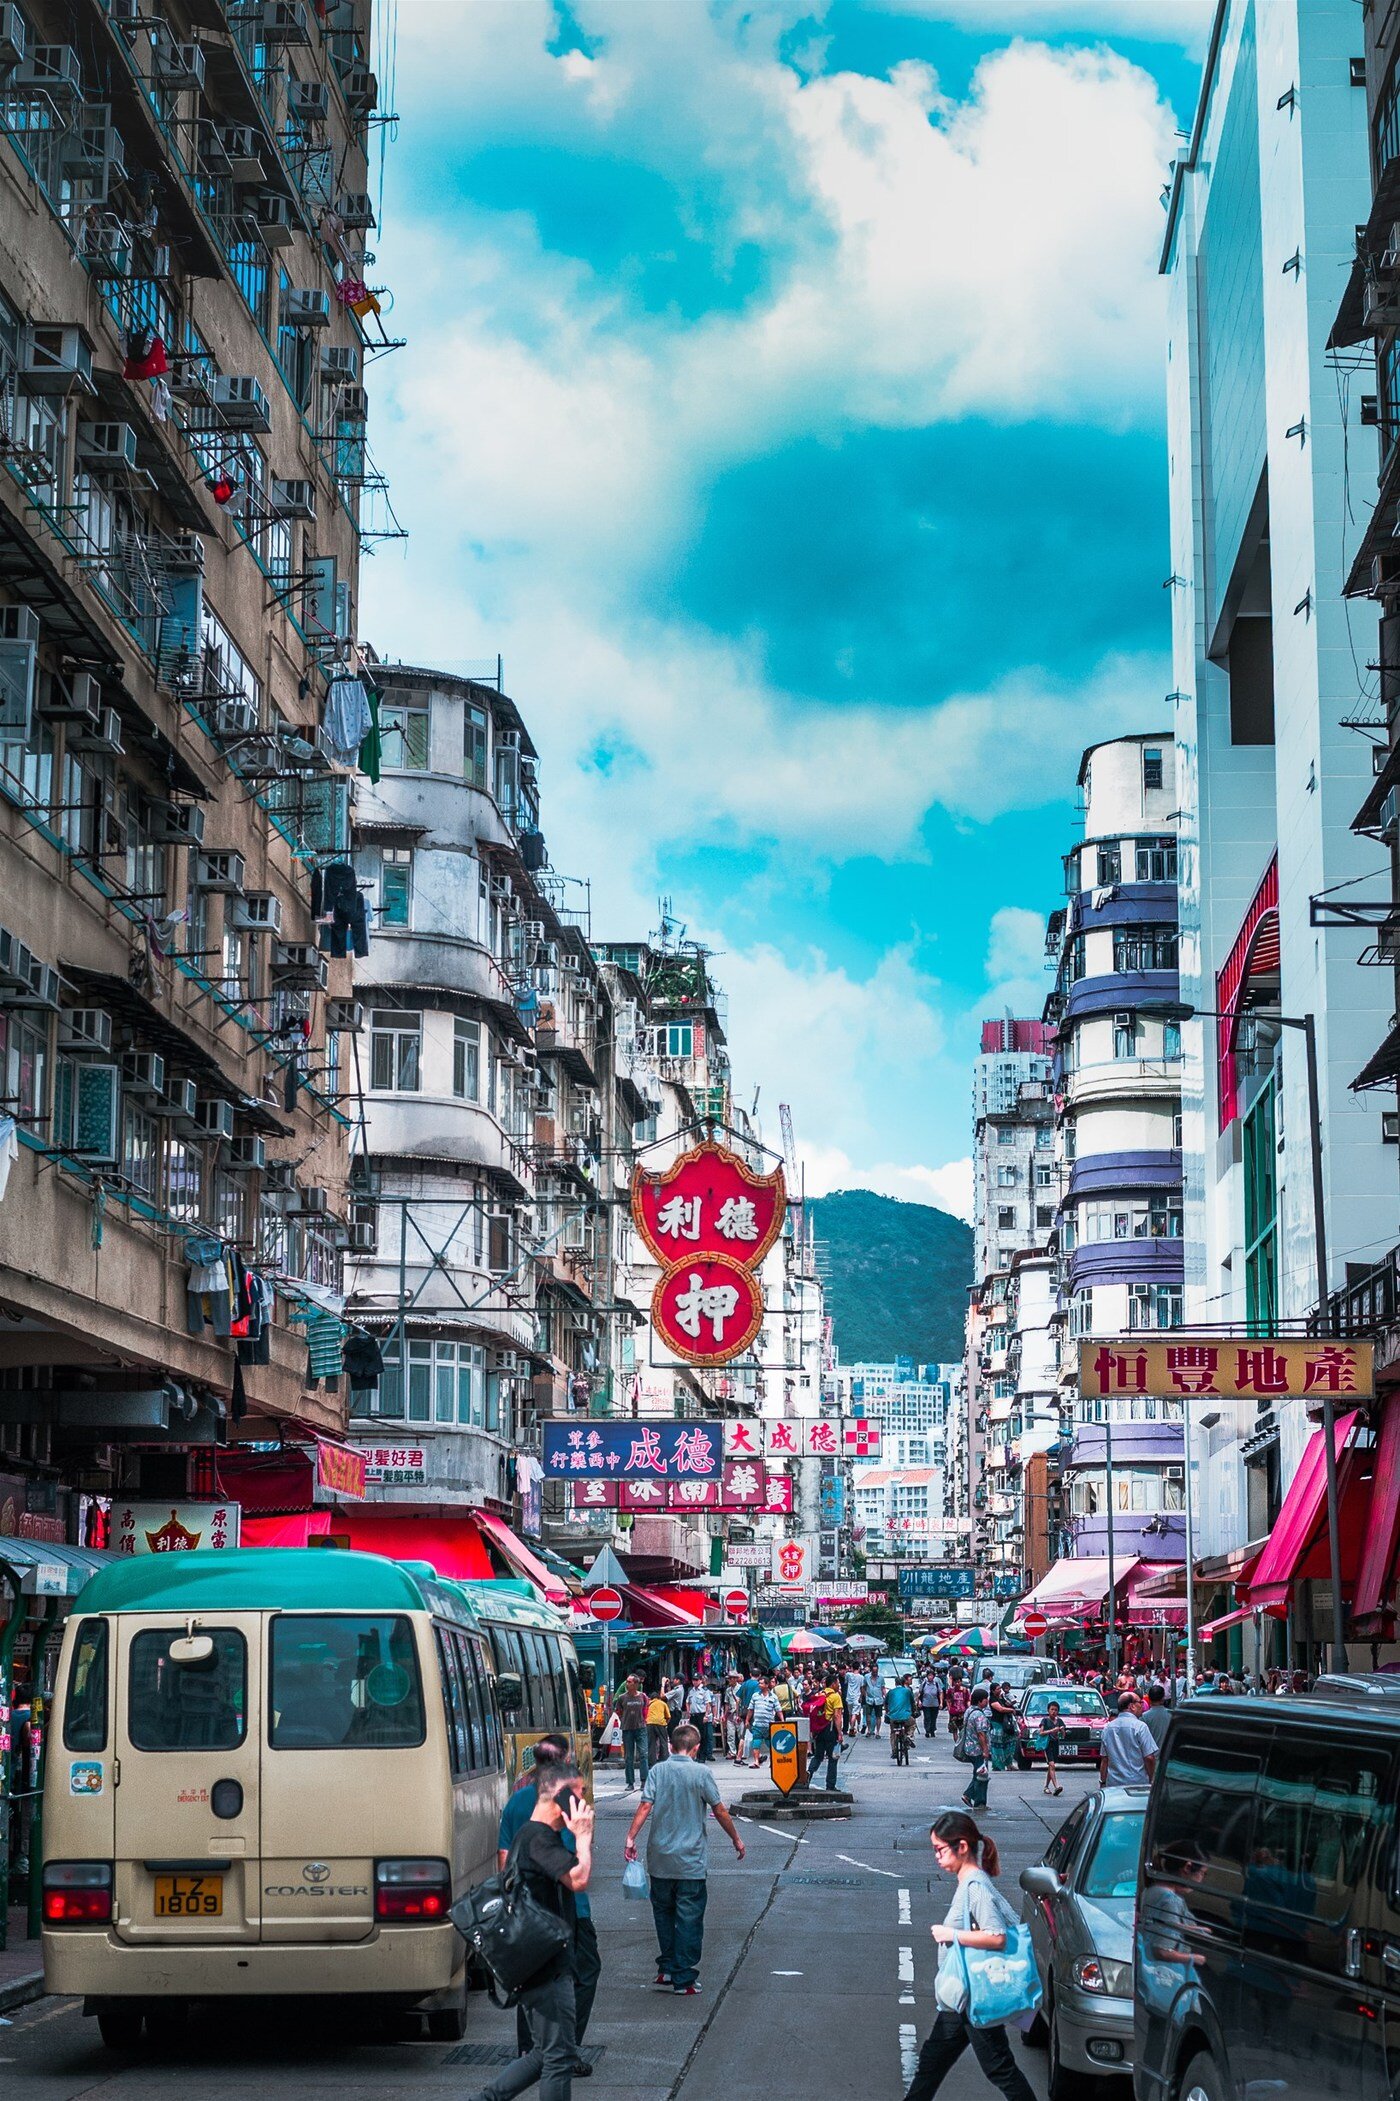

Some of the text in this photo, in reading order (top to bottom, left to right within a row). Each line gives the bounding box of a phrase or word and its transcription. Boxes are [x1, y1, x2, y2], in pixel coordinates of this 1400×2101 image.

[675, 1273, 739, 1342] 押
[1094, 1346, 1358, 1394] 恒豐地產
[784, 1563, 799, 1577] 押
[903, 1572, 971, 1584] 川龍地產
[172, 1878, 204, 1896] LZ
[264, 1885, 368, 1897] COASTER
[159, 1895, 219, 1914] 1809
